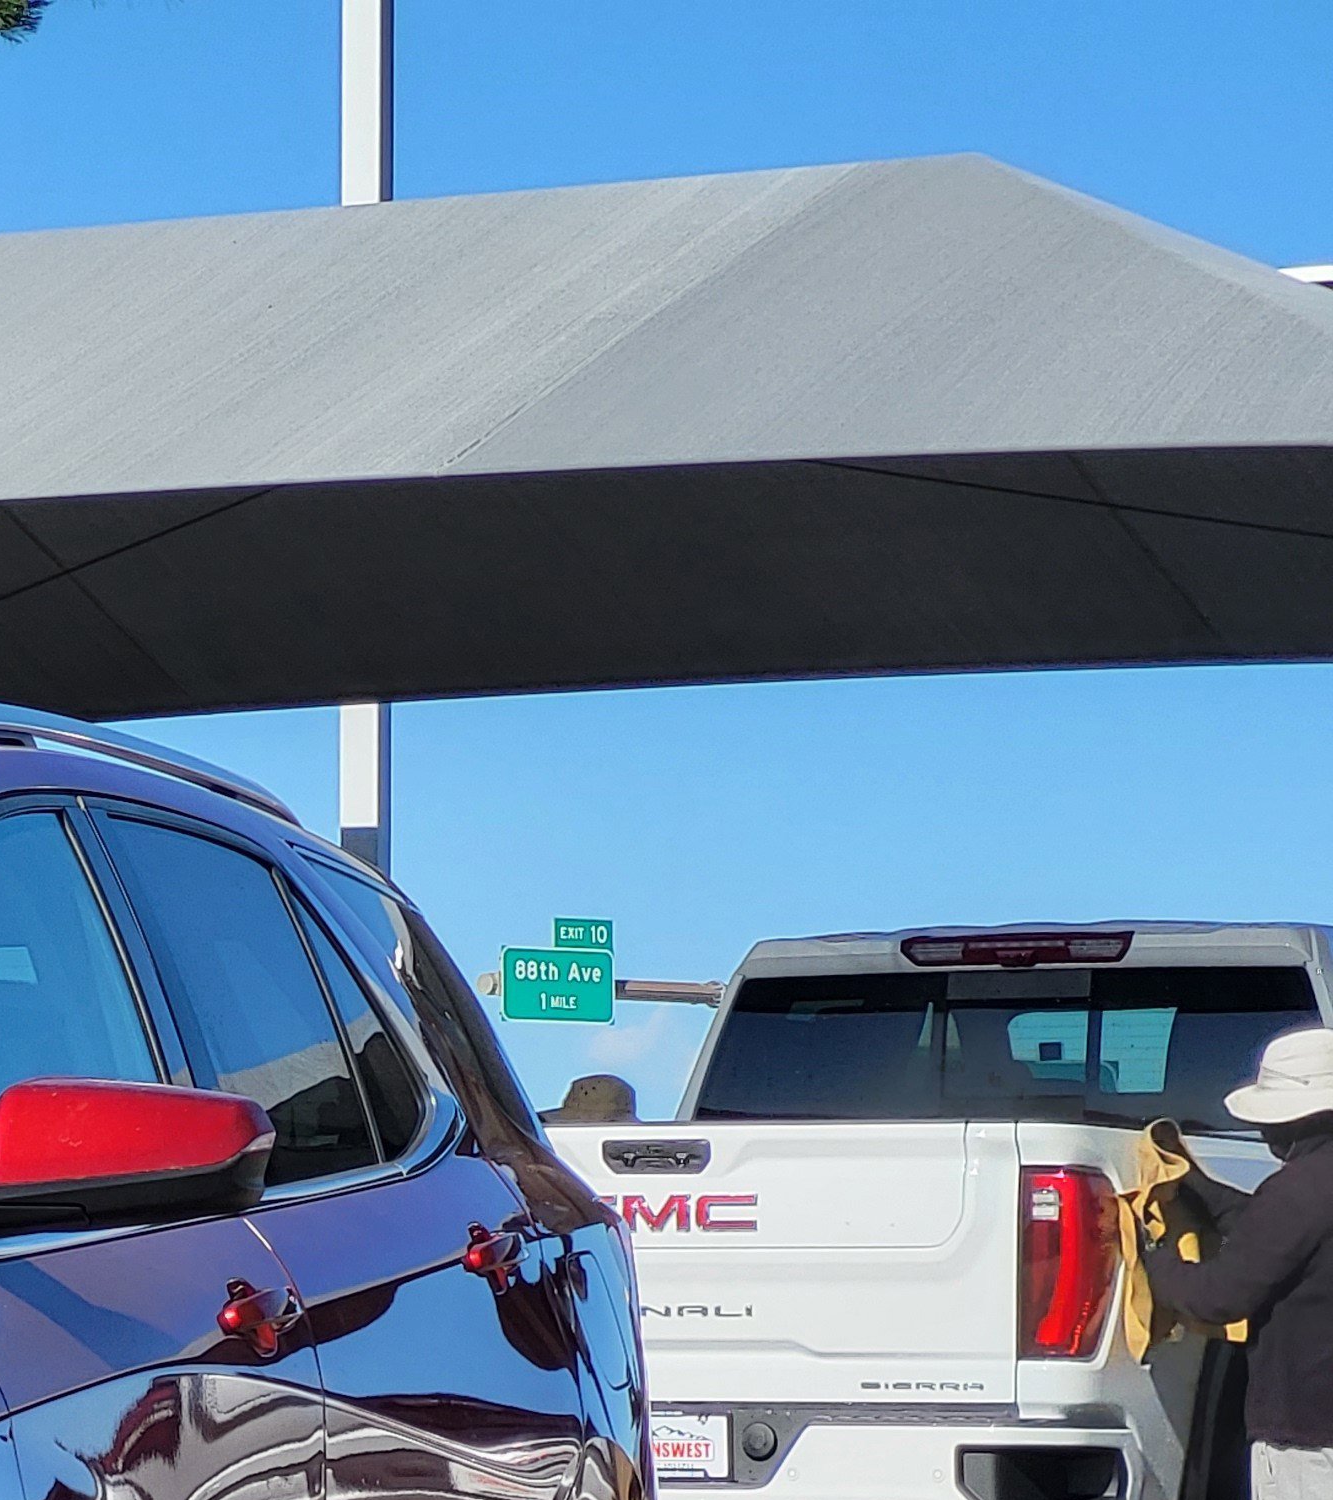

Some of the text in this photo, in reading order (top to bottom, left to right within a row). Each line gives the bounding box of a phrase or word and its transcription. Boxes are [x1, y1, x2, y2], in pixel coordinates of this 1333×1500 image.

[559, 925, 608, 944] EXIT 10
[515, 959, 602, 983] 88th Ave
[540, 992, 577, 1010] 1 MILE
[594, 1192, 759, 1233] MC
[640, 1304, 753, 1318] NALI
[860, 1381, 985, 1392] SIERRA
[652, 1442, 711, 1458] NSWEST
